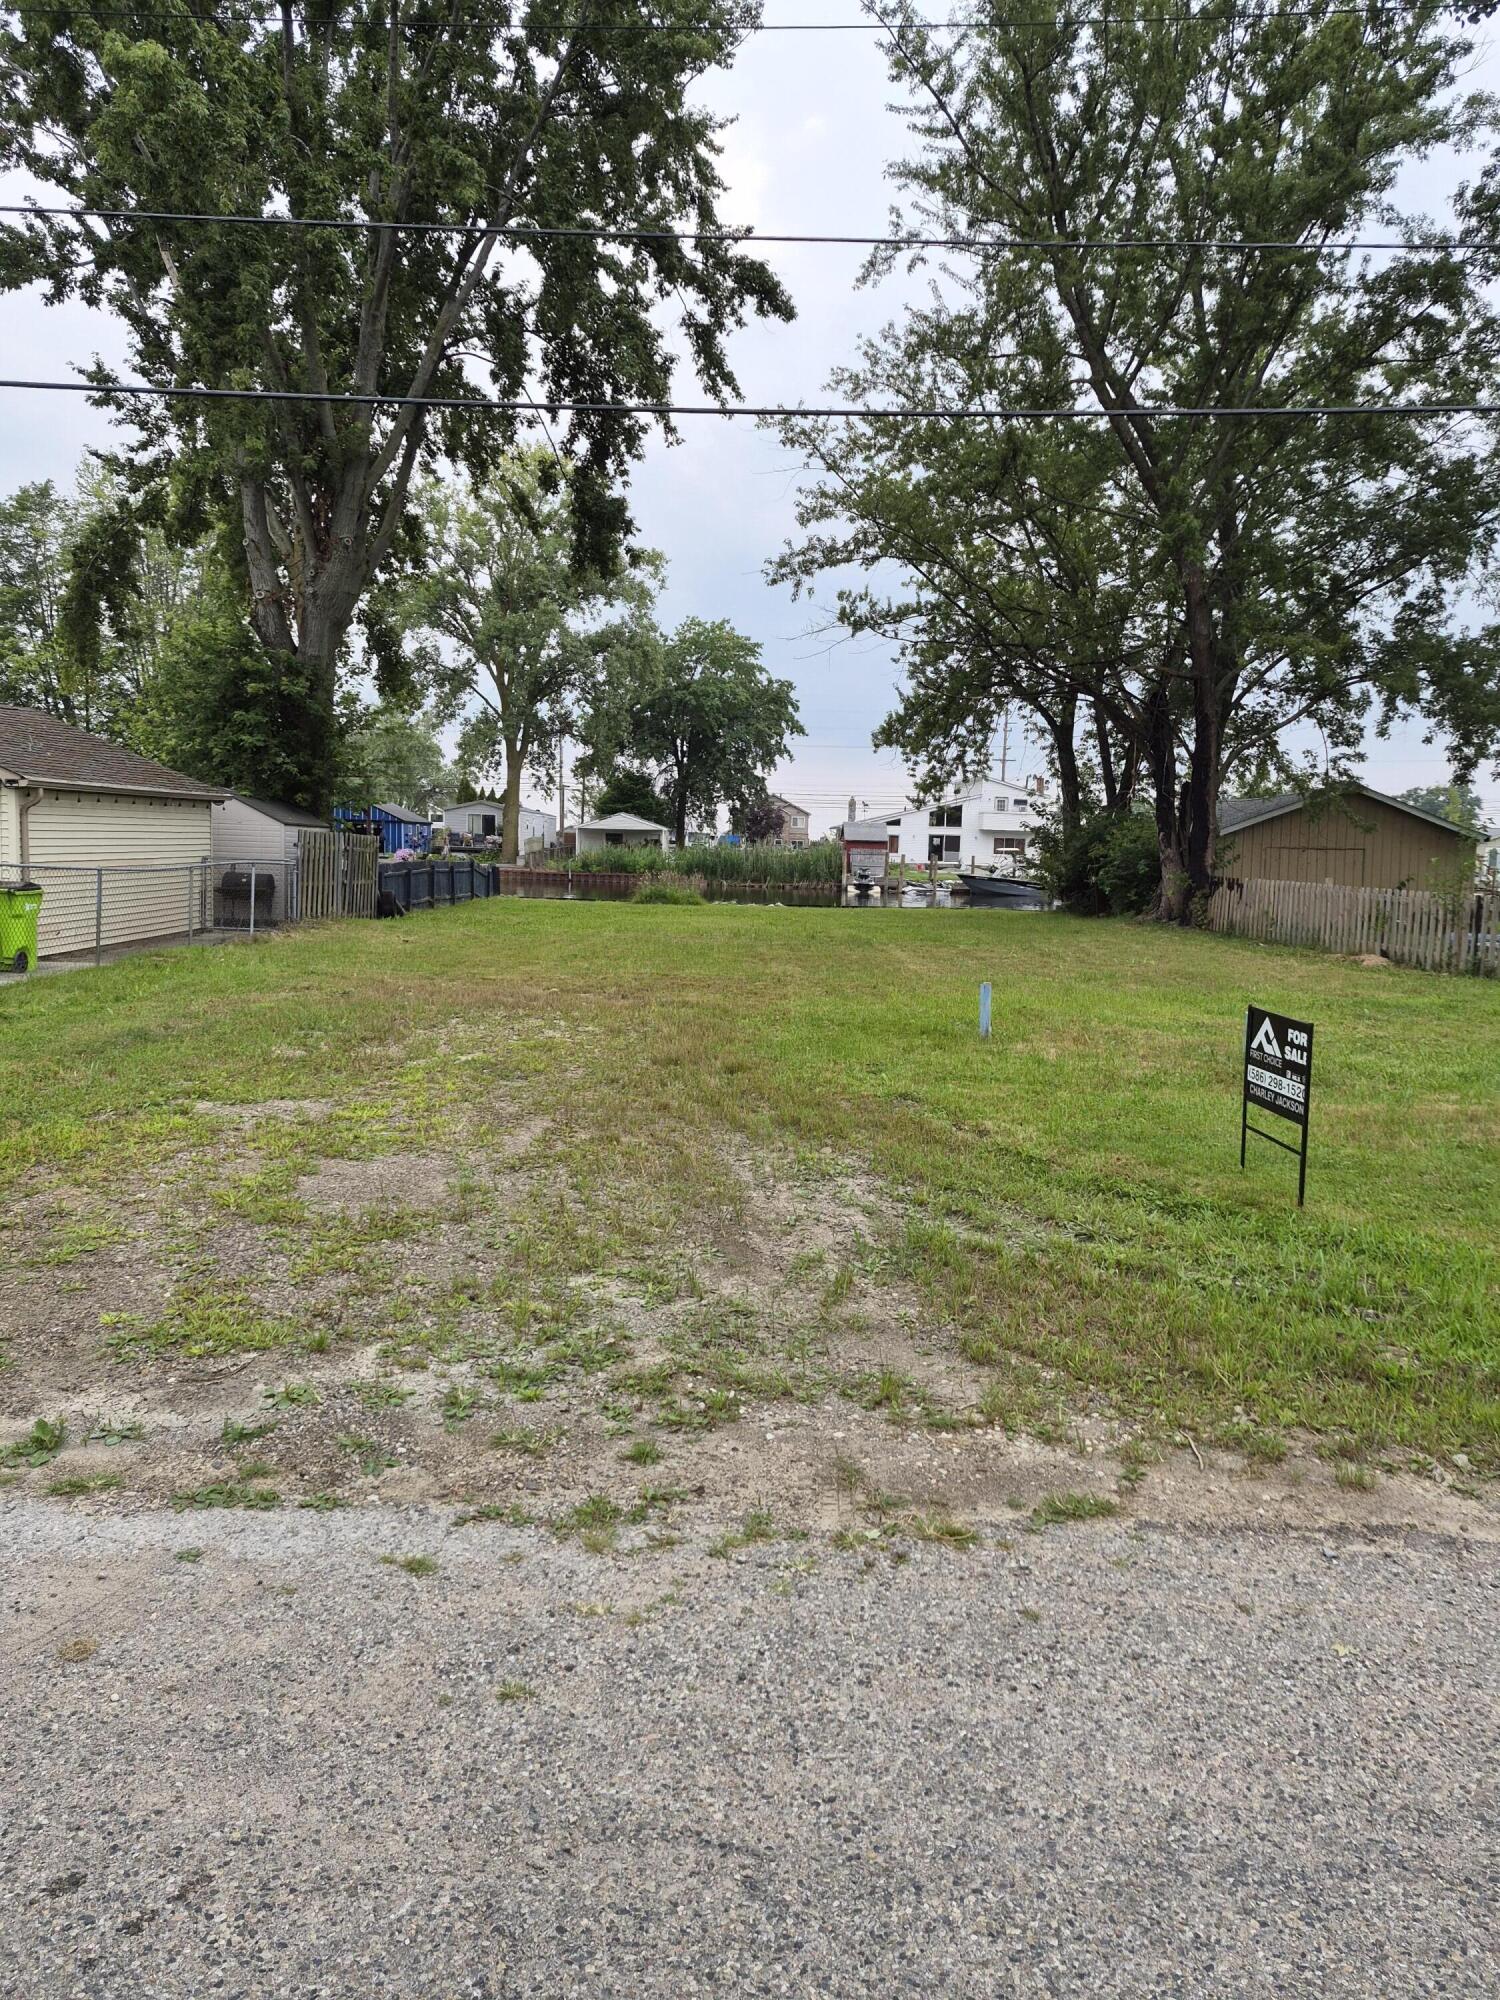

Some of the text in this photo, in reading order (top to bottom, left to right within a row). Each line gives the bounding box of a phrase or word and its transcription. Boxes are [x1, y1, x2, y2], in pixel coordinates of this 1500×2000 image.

[1287, 1028, 1308, 1047] FOR
[1250, 1048, 1282, 1068] FIRST CHOICE
[1249, 1067, 1266, 1083] (586)
[1249, 1084, 1304, 1115] CHARLEY JACKSON
